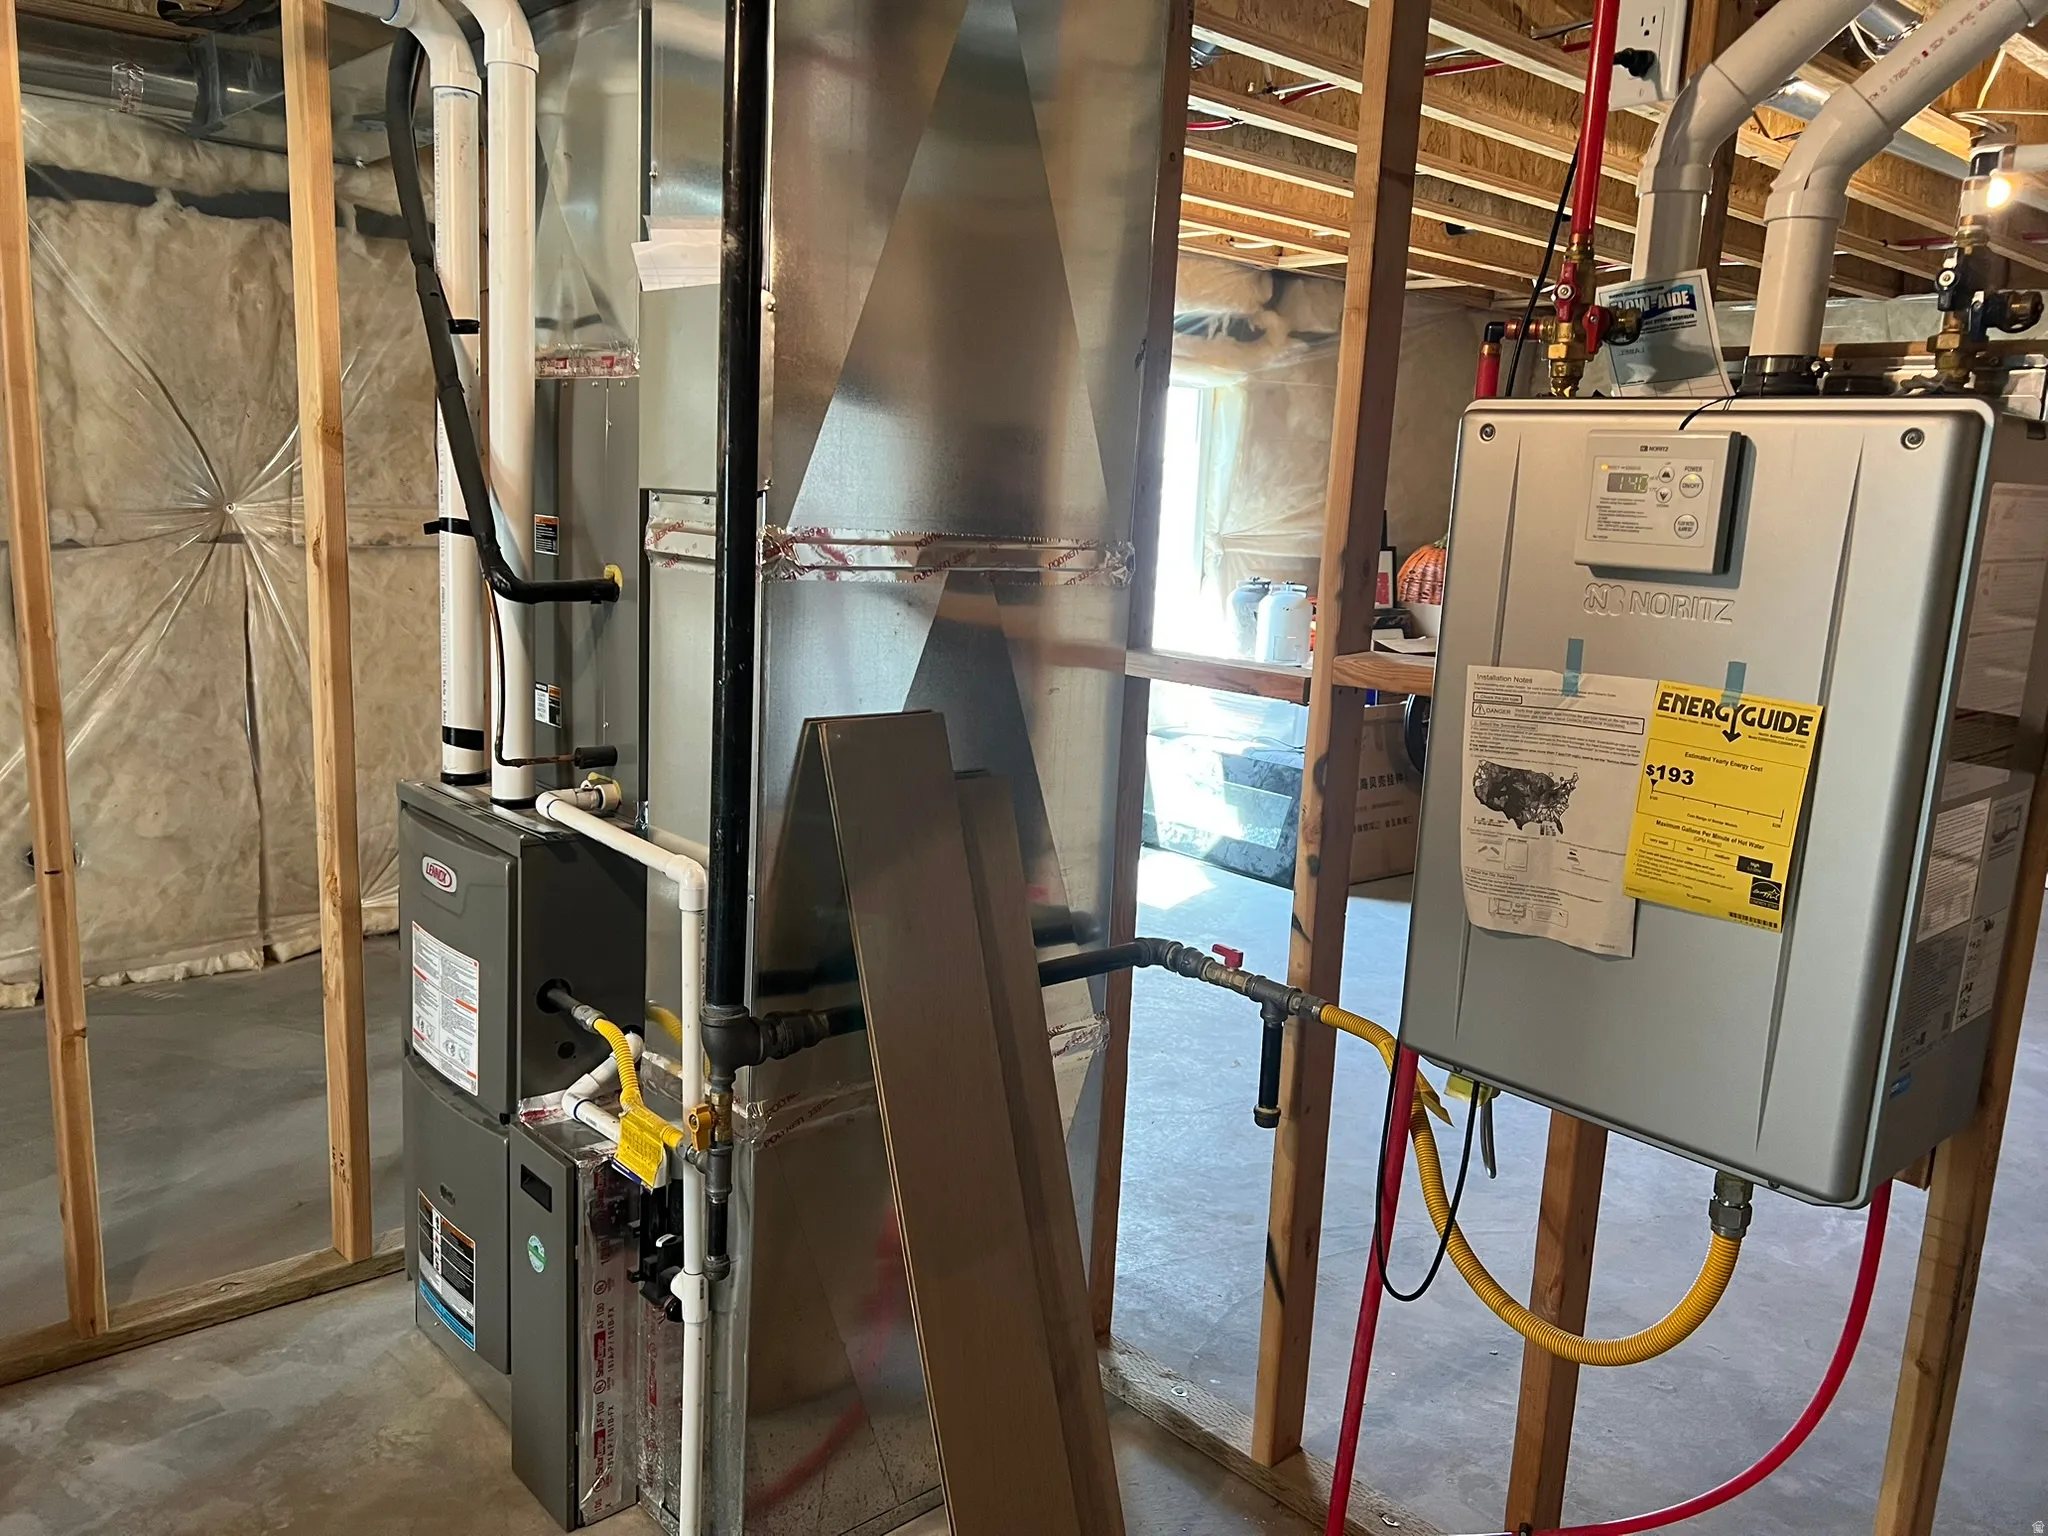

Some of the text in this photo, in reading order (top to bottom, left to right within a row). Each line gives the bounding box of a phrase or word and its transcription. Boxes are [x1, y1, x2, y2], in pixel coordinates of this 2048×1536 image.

[1630, 591, 1736, 624] NORITZ
[1477, 674, 1511, 682] Installation
[1685, 752, 1763, 772] Estimated Yearly Energy Cost
[1646, 764, 1694, 785] $193
[1656, 819, 1680, 830] Maximum
[1681, 825, 1701, 835] Gallons
[1713, 832, 1730, 842] Minute
[1738, 839, 1748, 847] Hot
[1748, 841, 1765, 849] Water
[426, 863, 446, 884] LENNOX
[594, 1302, 605, 1316] 100
[594, 1401, 605, 1415] 100
